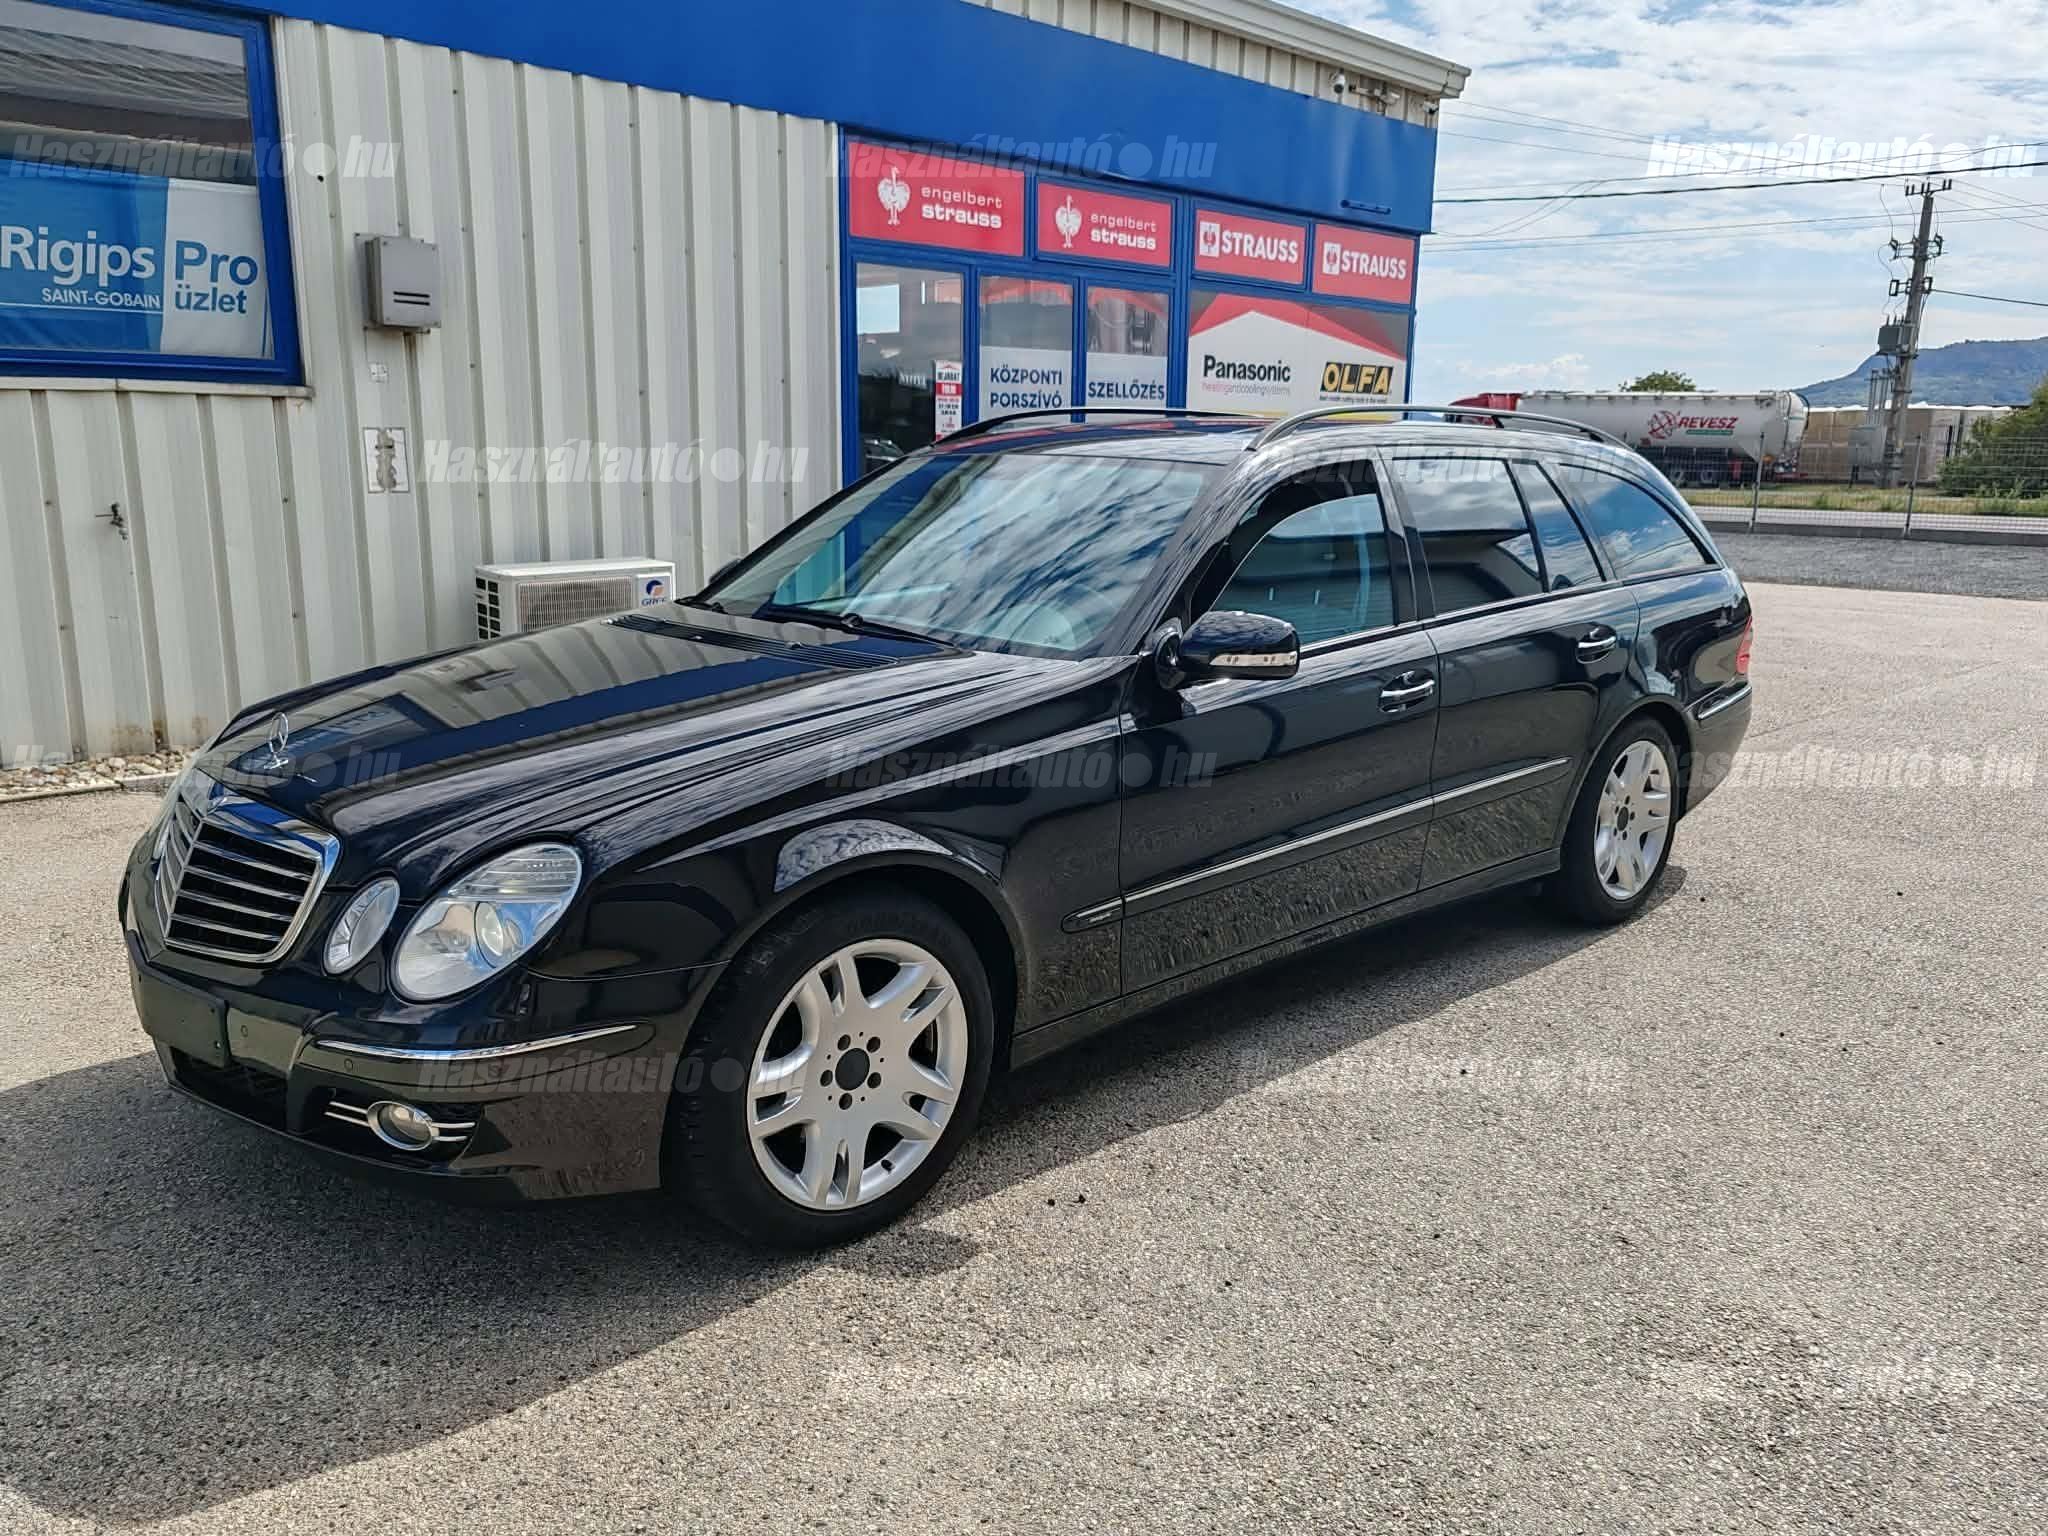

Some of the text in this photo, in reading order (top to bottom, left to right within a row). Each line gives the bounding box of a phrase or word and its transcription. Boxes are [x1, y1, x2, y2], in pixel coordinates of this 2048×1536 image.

[921, 185, 1002, 208] engelbert
[921, 204, 1003, 229] strauss
[1090, 213, 1157, 232] engelbert
[1090, 229, 1157, 250] strauss
[1222, 230, 1299, 264] STRAUSS
[0, 225, 155, 287] Rigips
[175, 240, 258, 285] Pro
[1342, 250, 1407, 280] STRAUSS
[42, 287, 161, 308] SAINT-GOBAIN
[175, 284, 247, 314] üzlet
[990, 365, 1062, 385] KÖZPONTI
[1203, 354, 1291, 382] Panasonic
[1322, 362, 1392, 395] OLFA
[990, 389, 1062, 409] PORSZÍVÓ
[1088, 379, 1165, 401] SZELLŐZÉS
